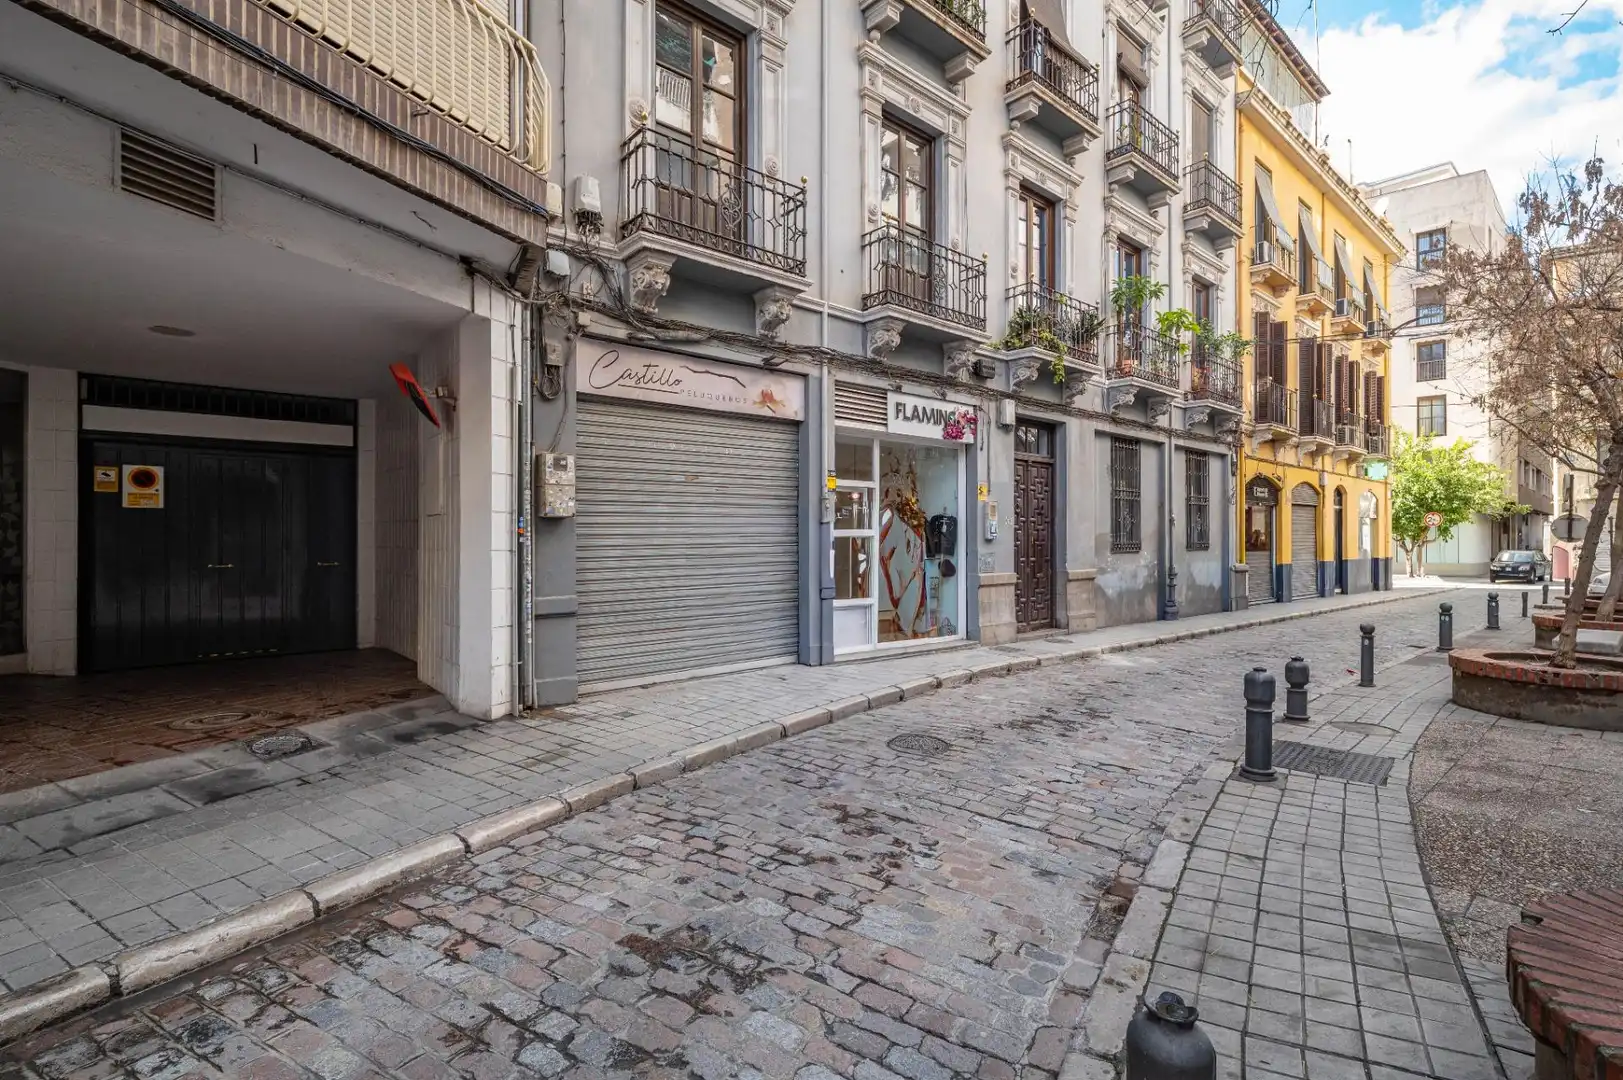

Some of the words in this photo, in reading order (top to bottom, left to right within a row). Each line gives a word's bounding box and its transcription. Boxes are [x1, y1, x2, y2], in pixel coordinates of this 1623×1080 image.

[588, 349, 682, 389] Castillo
[679, 388, 748, 404] PELUQUEROS
[894, 402, 963, 428] FLAMIN
